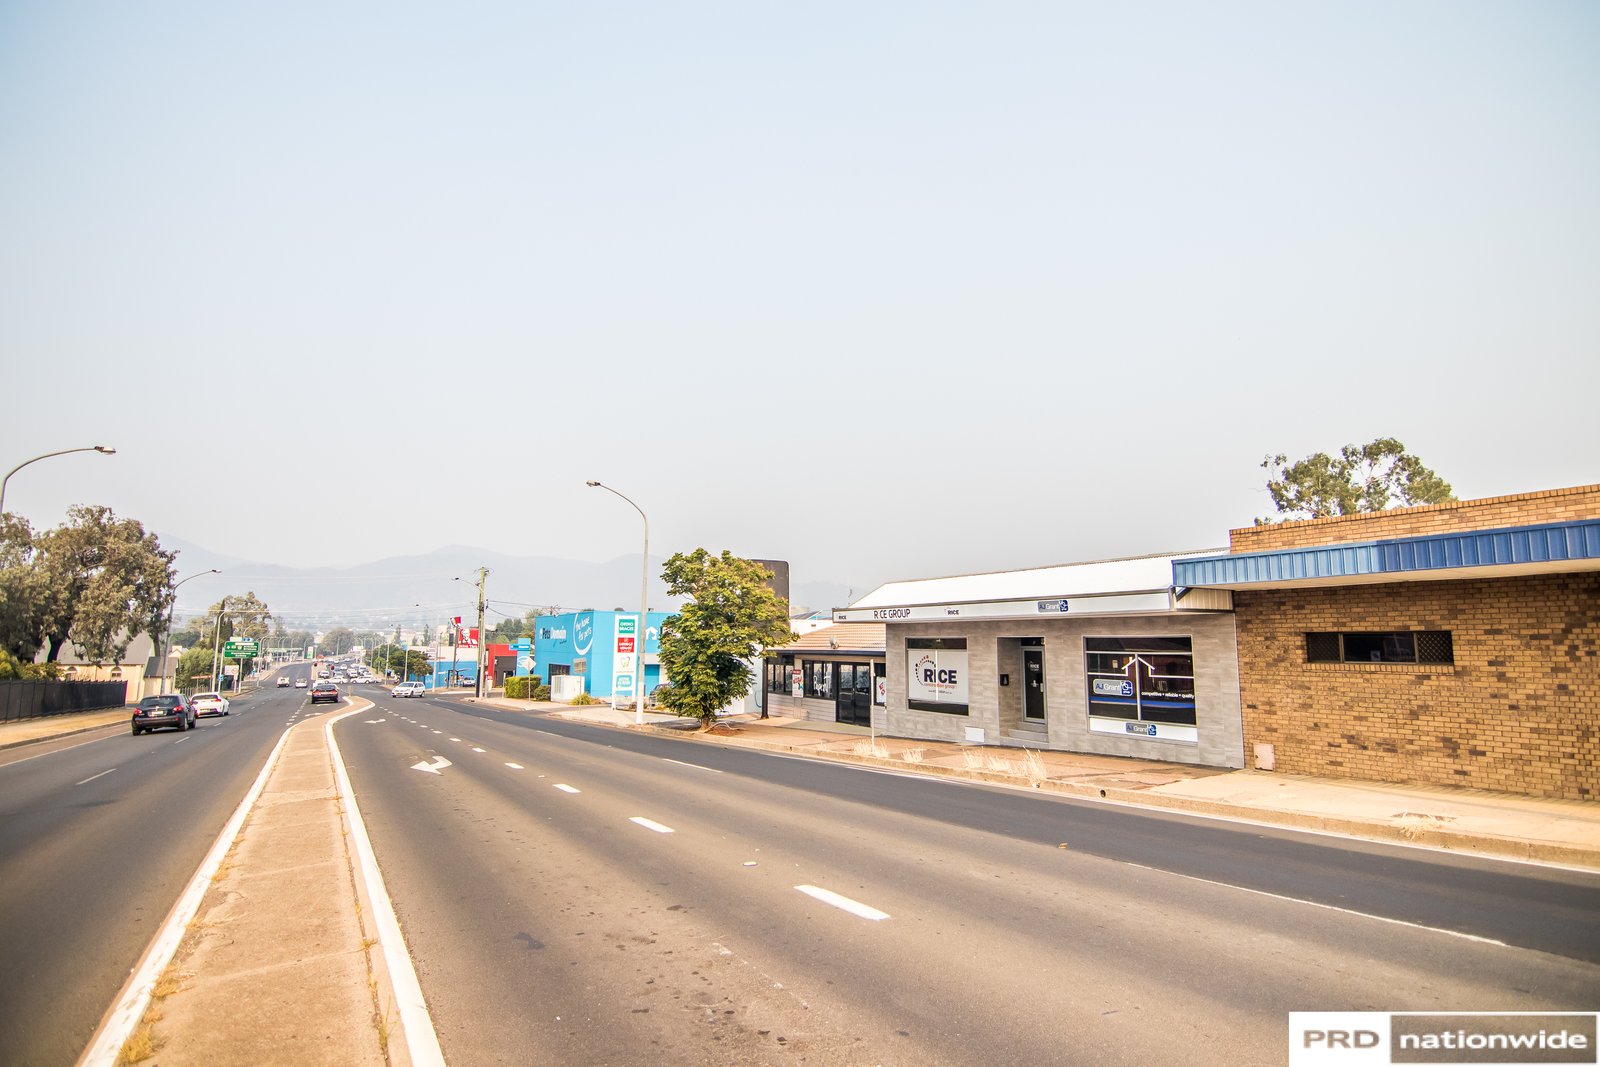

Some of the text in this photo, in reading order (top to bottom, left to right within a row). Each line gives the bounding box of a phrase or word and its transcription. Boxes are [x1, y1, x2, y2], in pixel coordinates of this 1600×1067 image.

[889, 608, 911, 619] GROUP
[542, 625, 567, 640] Pets Domain
[924, 668, 957, 685] RICE
[1104, 683, 1120, 691] Grant
